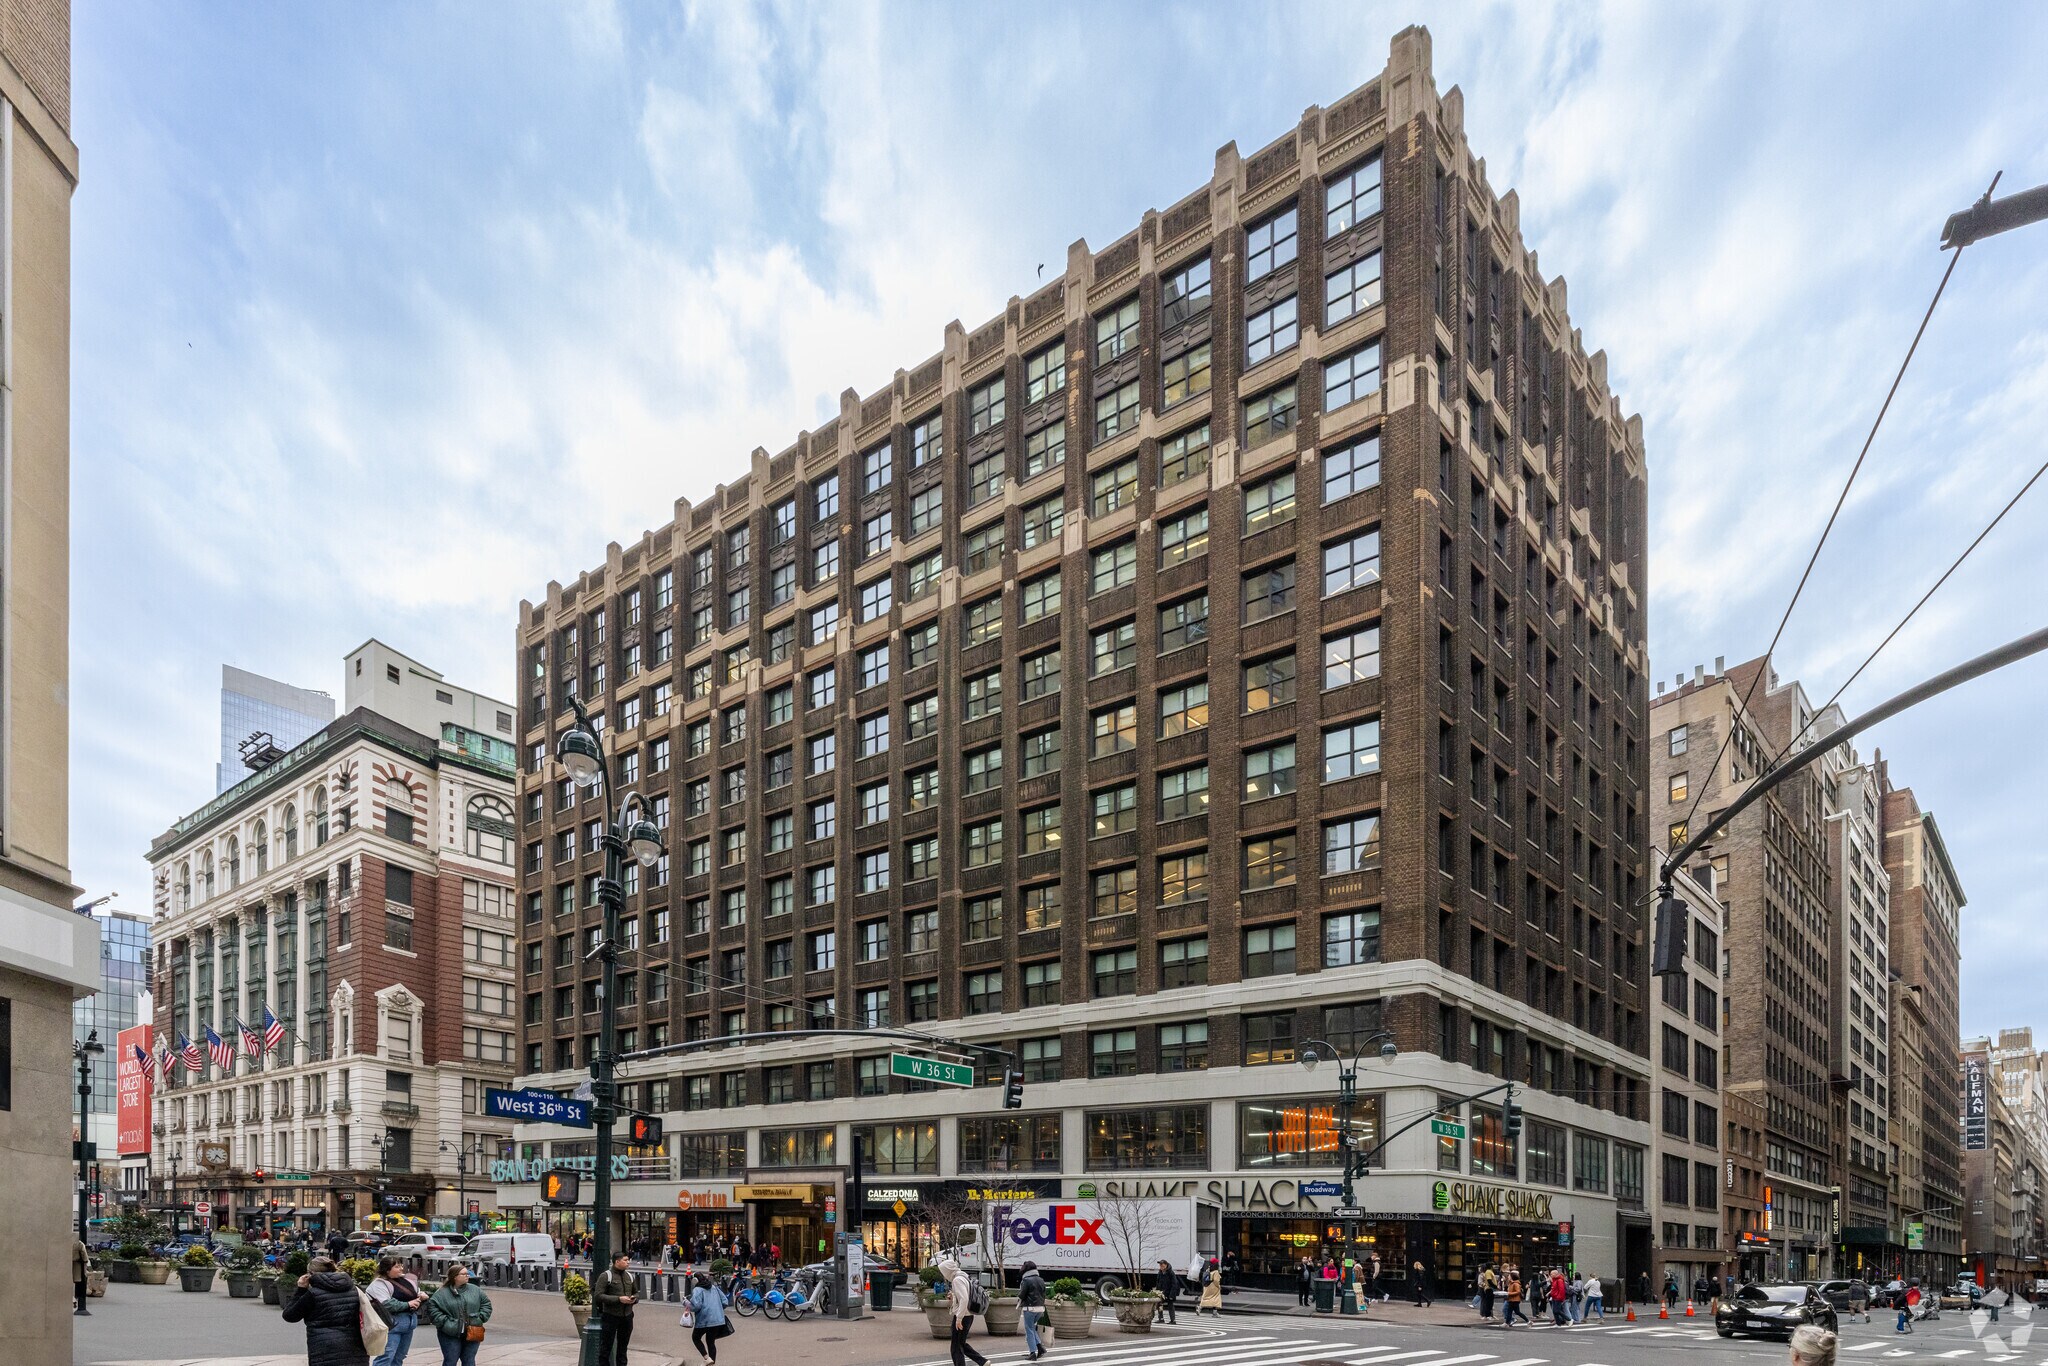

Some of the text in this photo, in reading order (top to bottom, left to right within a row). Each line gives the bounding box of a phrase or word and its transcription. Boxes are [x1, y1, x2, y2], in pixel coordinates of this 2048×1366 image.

[912, 1061, 955, 1080] W 36 St
[120, 1075, 142, 1093] LARGEST
[1968, 1060, 1984, 1114] KAUFMAN
[122, 1091, 139, 1109] STORE
[496, 1096, 581, 1120] West 36th St
[1438, 1123, 1444, 1133] W
[867, 1189, 919, 1198] CALZEDONIA
[983, 1189, 1035, 1200] Martens
[1207, 1180, 1318, 1209] SHACK
[1304, 1186, 1336, 1194] Broadway
[712, 1193, 727, 1208] BAR
[1451, 1182, 1553, 1220] SHAKE SHACK
[993, 1205, 1105, 1245] FedEx
[1055, 1247, 1091, 1259] Ground
